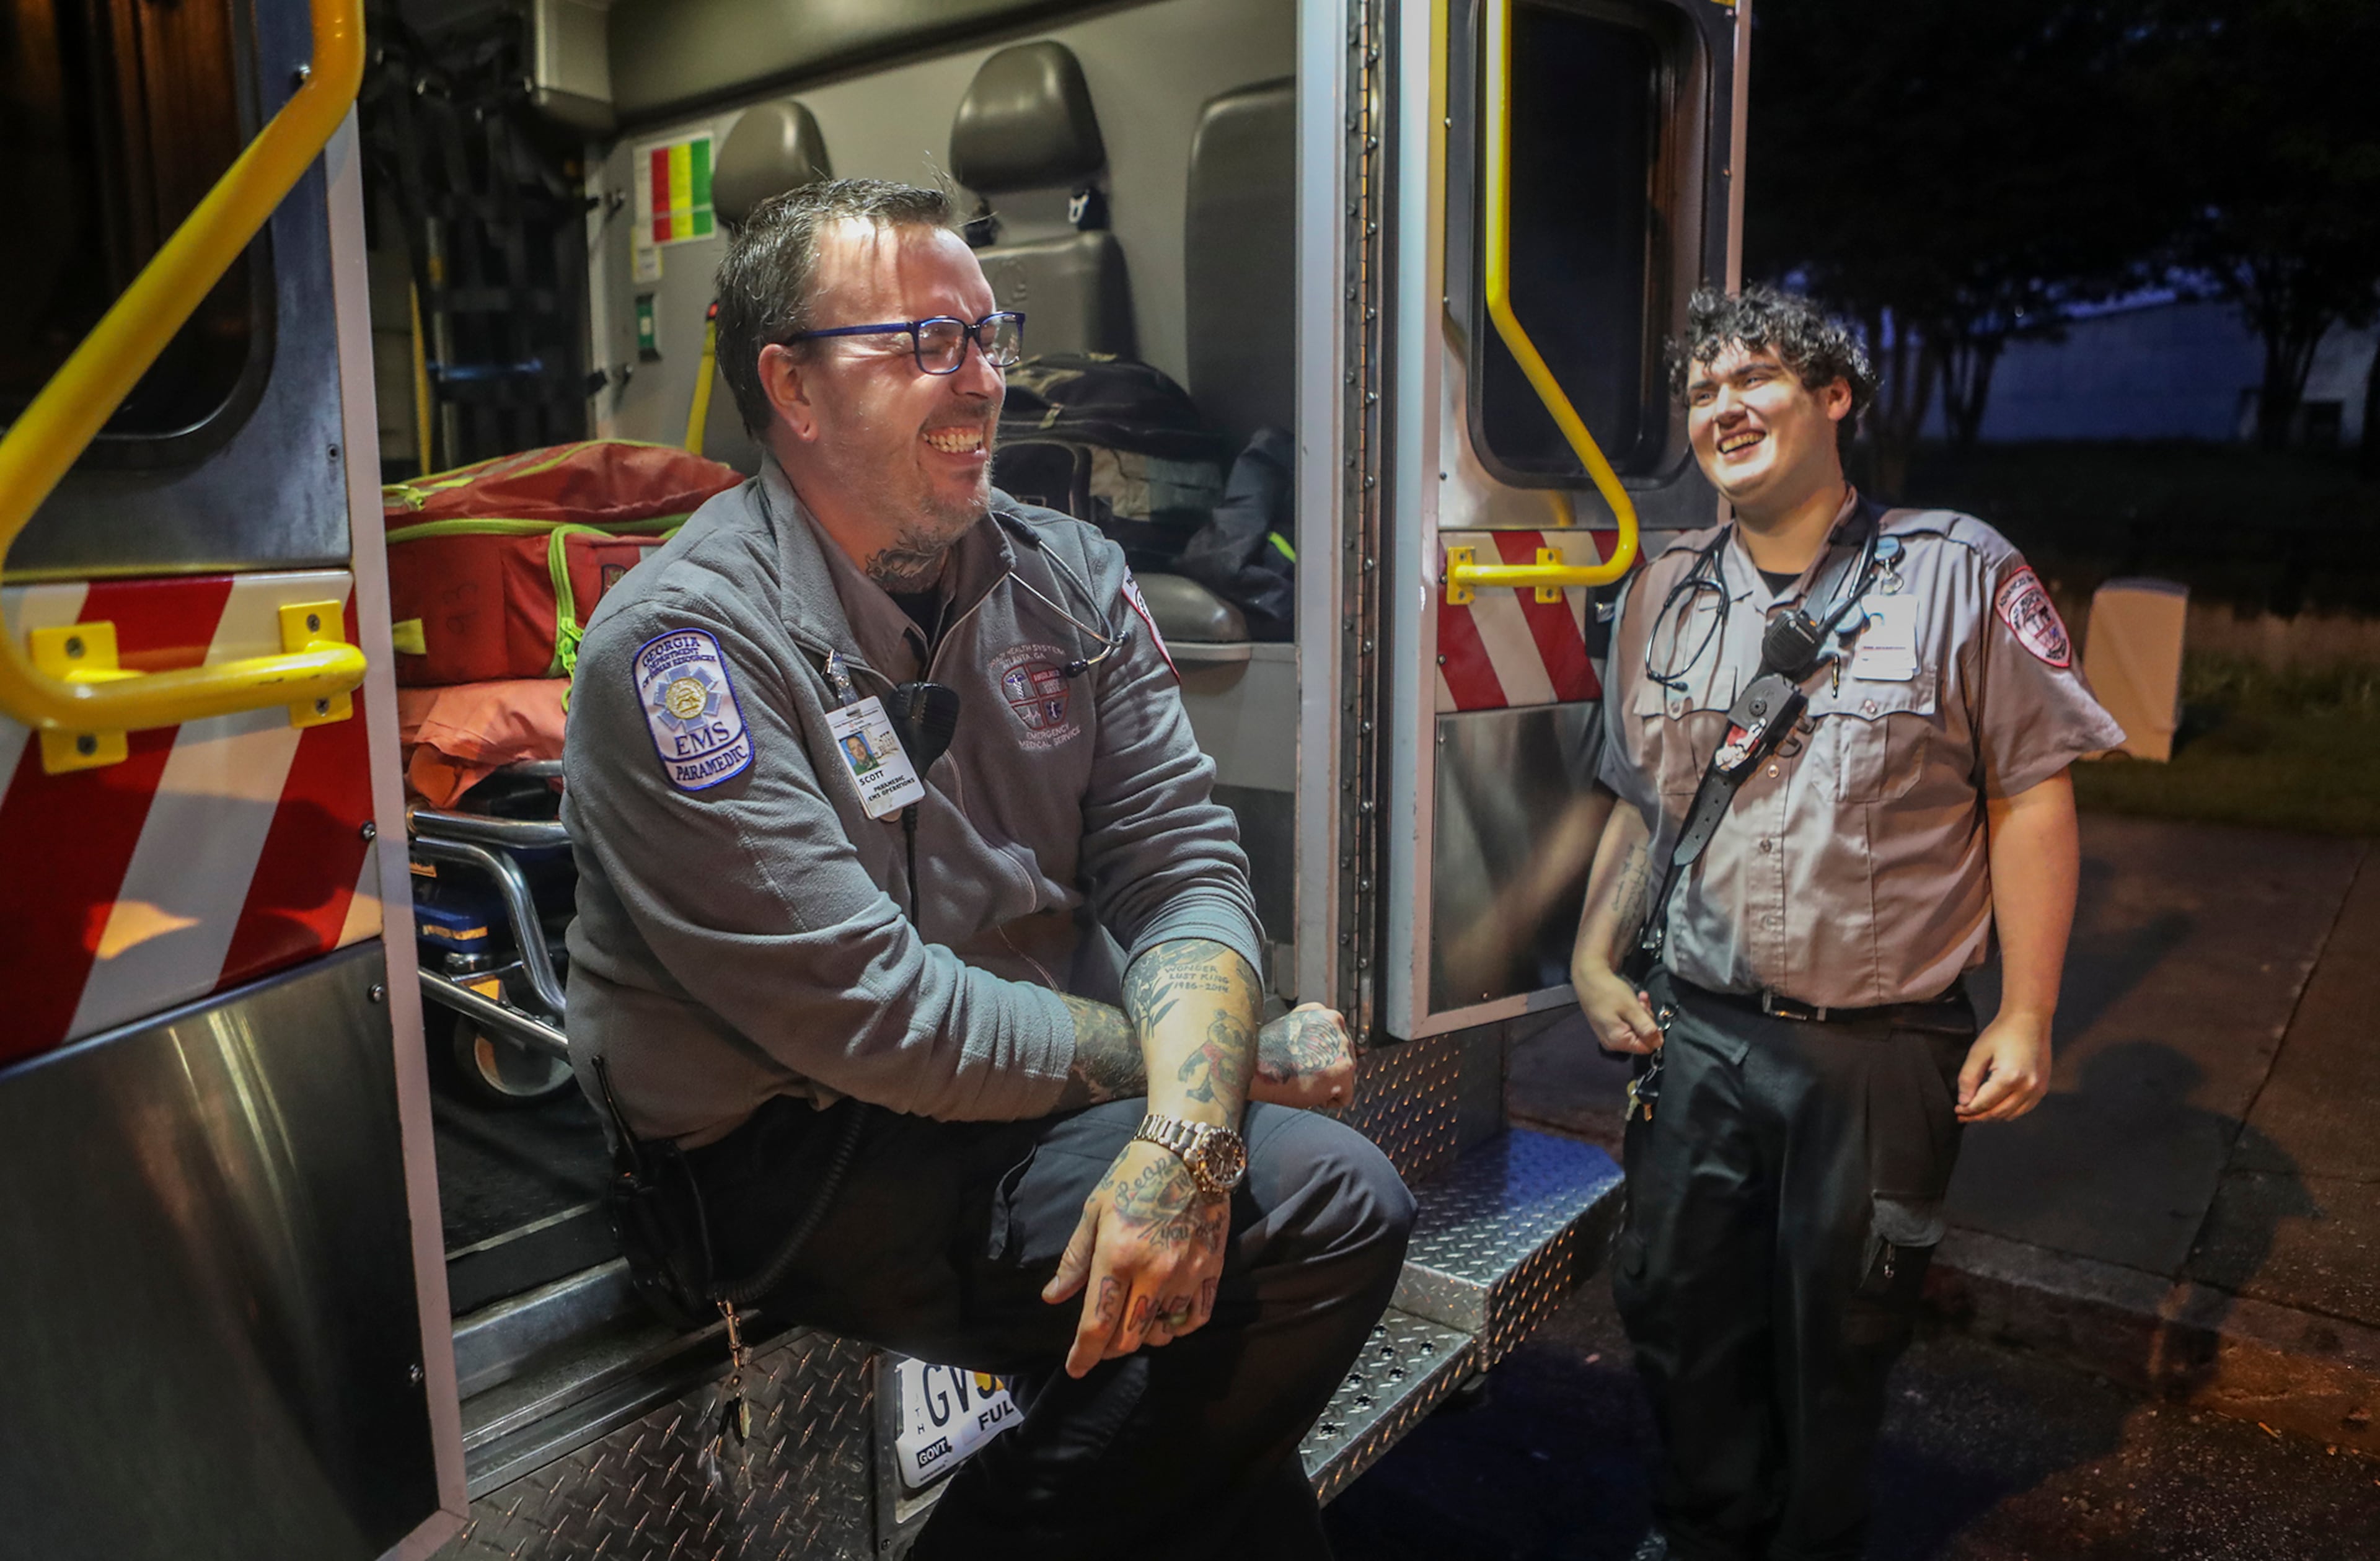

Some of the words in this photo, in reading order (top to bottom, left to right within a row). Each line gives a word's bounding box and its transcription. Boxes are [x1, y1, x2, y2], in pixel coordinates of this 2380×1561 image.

[642, 636, 701, 667] GEORGIA
[674, 721, 730, 756] EMS
[1026, 723, 1070, 740] EMERGENCY
[1054, 726, 1081, 745] SERVICE
[676, 745, 748, 781] PARAMEDIC
[859, 770, 884, 786] SCOTT
[868, 793, 881, 802] EMS
[881, 777, 915, 797] OPERATIONS
[873, 775, 904, 792] PARAMEDIC
[977, 1401, 1014, 1431] FUL
[918, 1439, 948, 1465] GOVT
